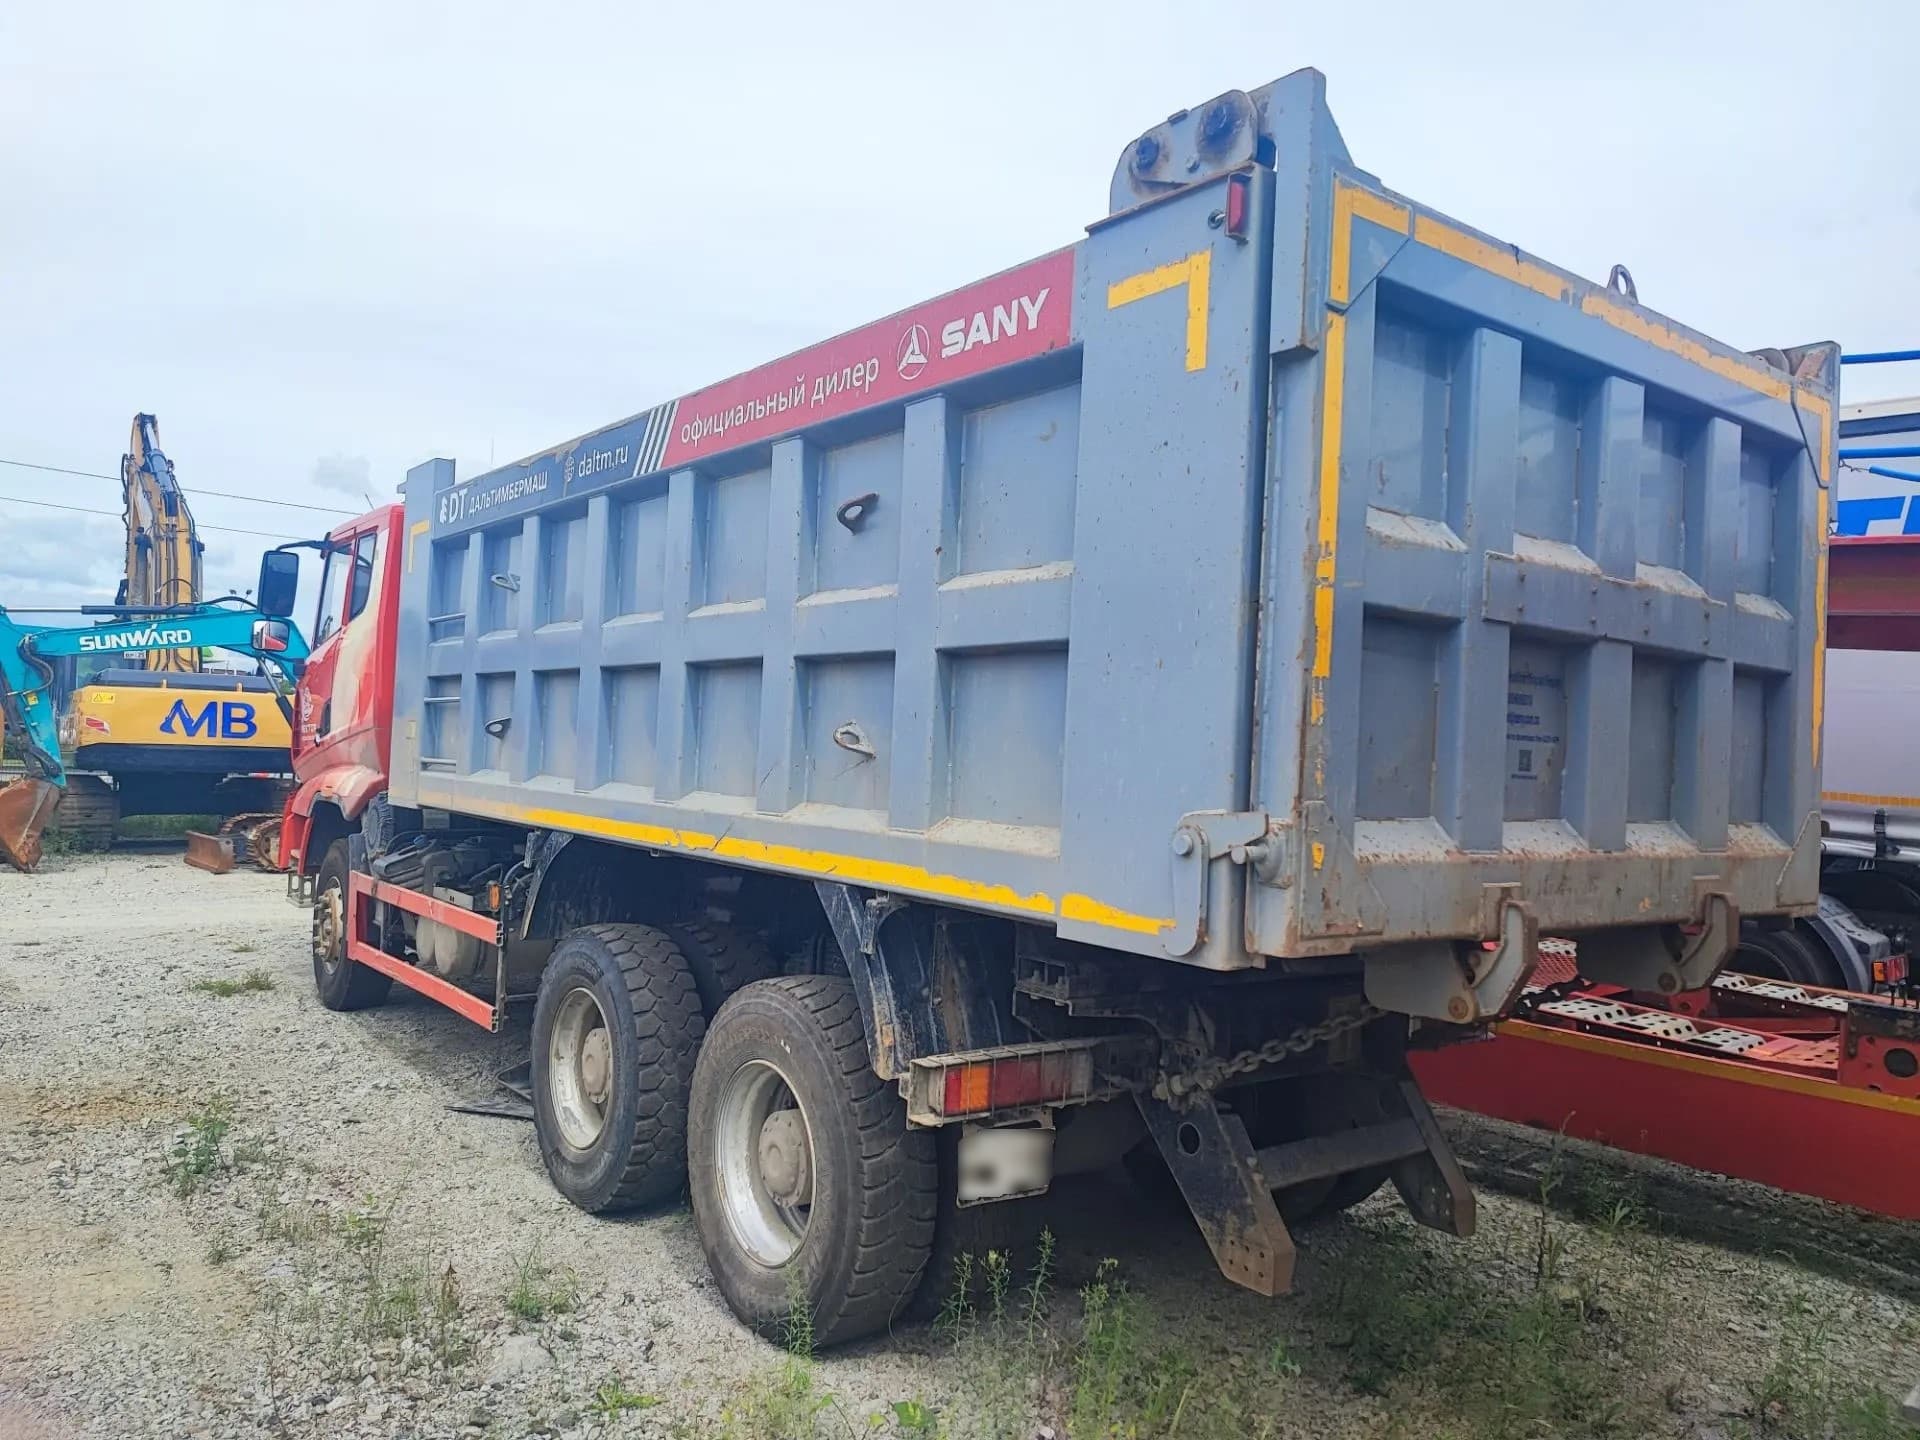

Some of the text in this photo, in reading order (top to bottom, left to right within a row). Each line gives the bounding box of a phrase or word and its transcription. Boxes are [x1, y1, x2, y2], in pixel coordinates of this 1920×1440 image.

[941, 287, 1050, 359] SANY
[681, 355, 879, 448] официальный дилер
[578, 445, 629, 477] daltm.ru
[448, 471, 549, 523] DT ДАЛЬТИМБЕРМАШ
[79, 625, 192, 651] SUNWARD
[160, 698, 258, 739] MB
